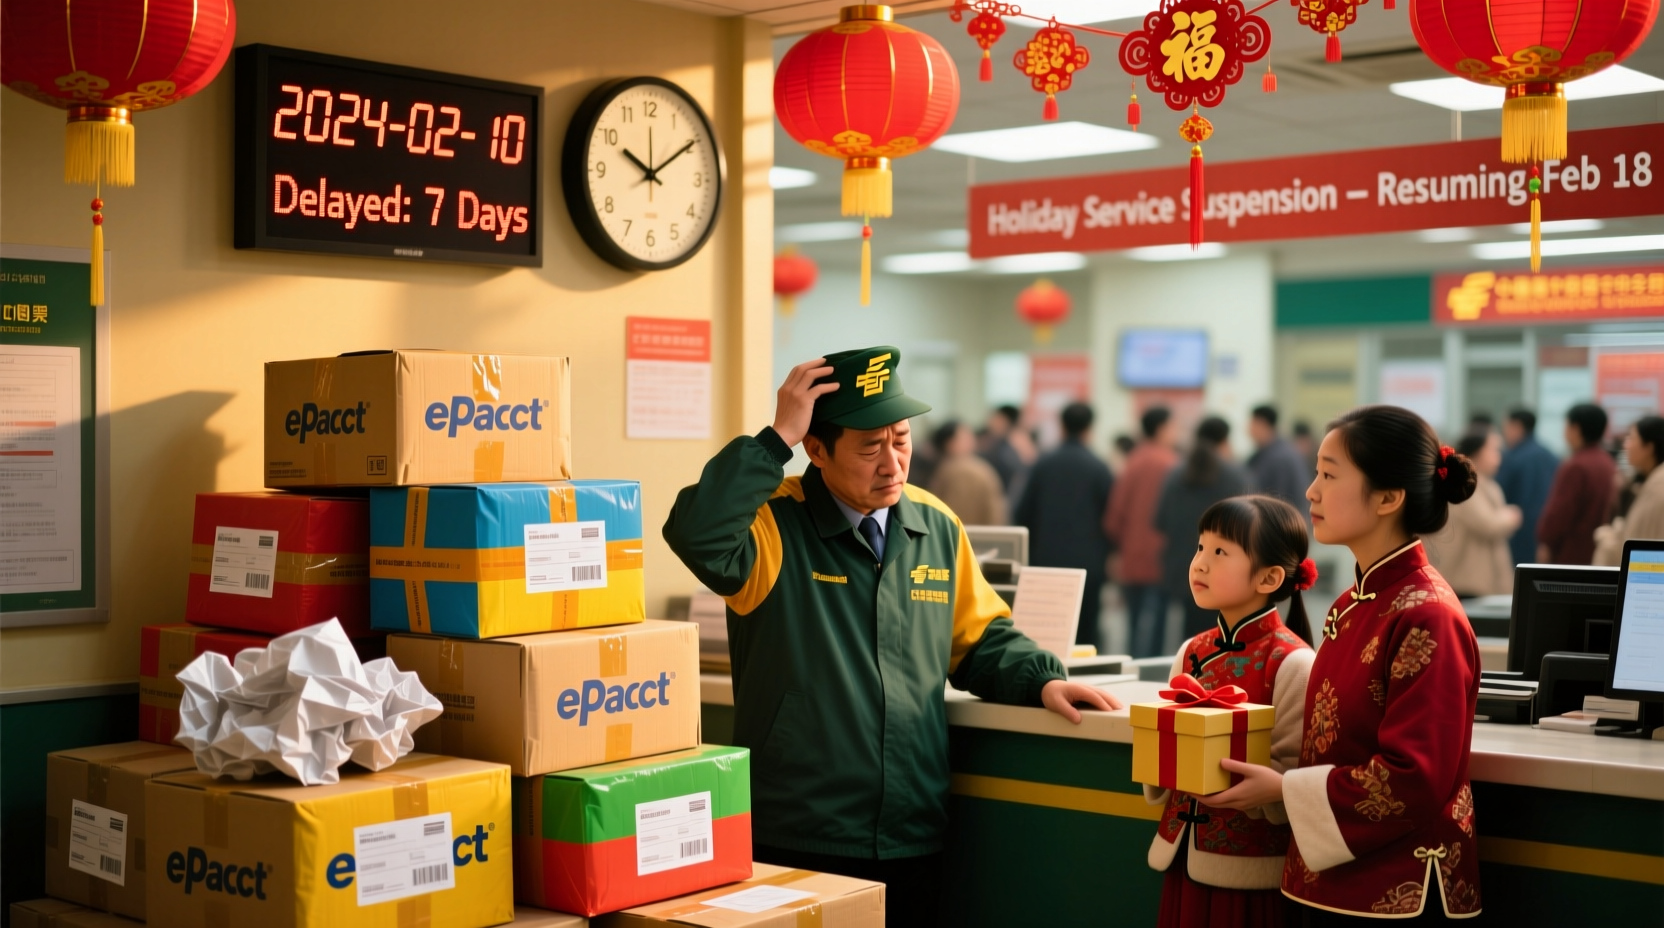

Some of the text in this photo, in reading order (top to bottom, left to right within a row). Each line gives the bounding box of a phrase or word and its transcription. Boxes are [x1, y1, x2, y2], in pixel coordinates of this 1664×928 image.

[1159, 9, 1226, 83] 福
[621, 105, 633, 123] 11
[643, 100, 658, 118] 12
[671, 113, 676, 130] 1
[603, 128, 618, 146] 10
[596, 161, 606, 179] 9
[693, 172, 702, 188] 3
[604, 195, 614, 214] 8
[987, 198, 1080, 240] Holiday
[1083, 190, 1176, 229] Service
[1377, 163, 1527, 206] Resuming
[1542, 154, 1601, 194] Feb
[1612, 151, 1653, 188] 18
[273, 174, 529, 241] Delayed: 7 Days
[685, 203, 695, 219] 4
[622, 219, 633, 236] 7
[669, 223, 679, 241] 5
[645, 229, 656, 248] 6
